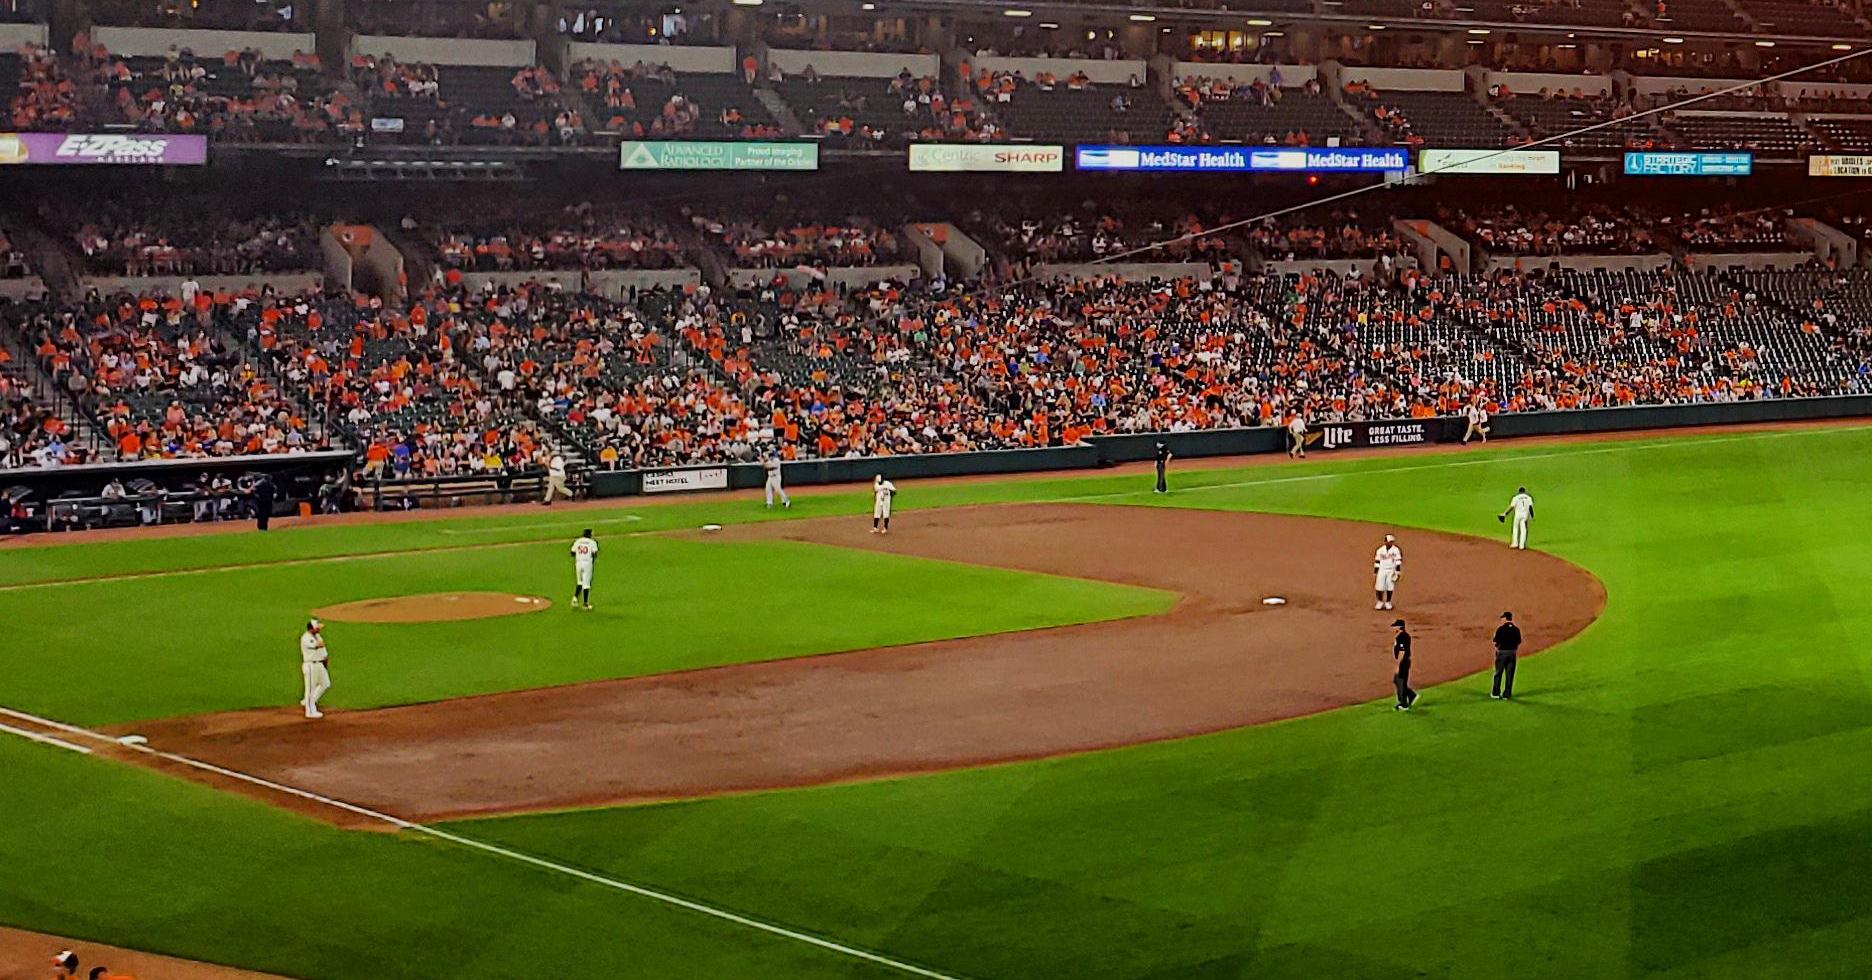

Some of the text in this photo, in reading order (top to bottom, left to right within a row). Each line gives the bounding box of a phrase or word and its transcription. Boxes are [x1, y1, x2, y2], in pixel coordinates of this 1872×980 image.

[663, 143, 724, 156] ADVANCED
[661, 155, 726, 167] RADIOLOGY
[994, 152, 1058, 164] SHARP
[1141, 151, 1246, 168] MedStar Health
[1307, 152, 1404, 169] MedStar Health
[1643, 154, 1697, 164] STRATEGIC
[1643, 164, 1697, 173] FACTORY
[1369, 424, 1425, 436] GREAT TASTE.
[1323, 427, 1353, 449] Lite
[1370, 435, 1390, 445] LESS
[577, 546, 589, 555] 50
